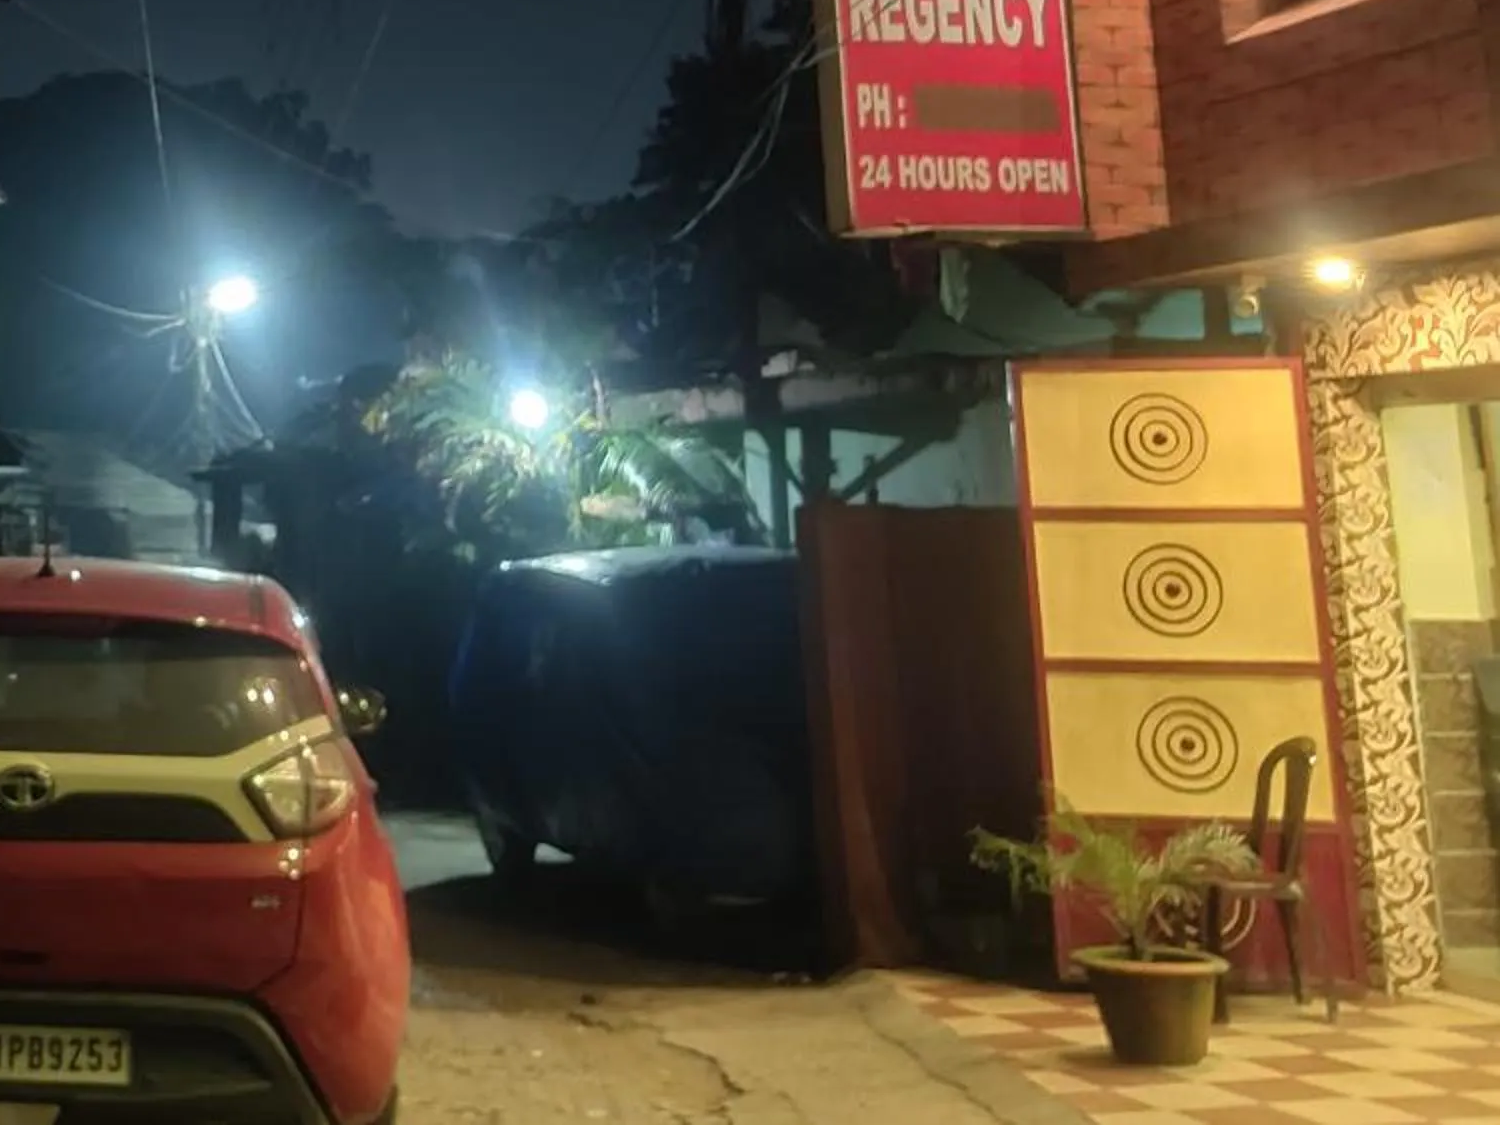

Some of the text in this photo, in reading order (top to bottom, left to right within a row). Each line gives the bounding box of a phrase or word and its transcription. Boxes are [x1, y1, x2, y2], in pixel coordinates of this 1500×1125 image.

[858, 155, 1070, 194] 24 HOURS OPEN
